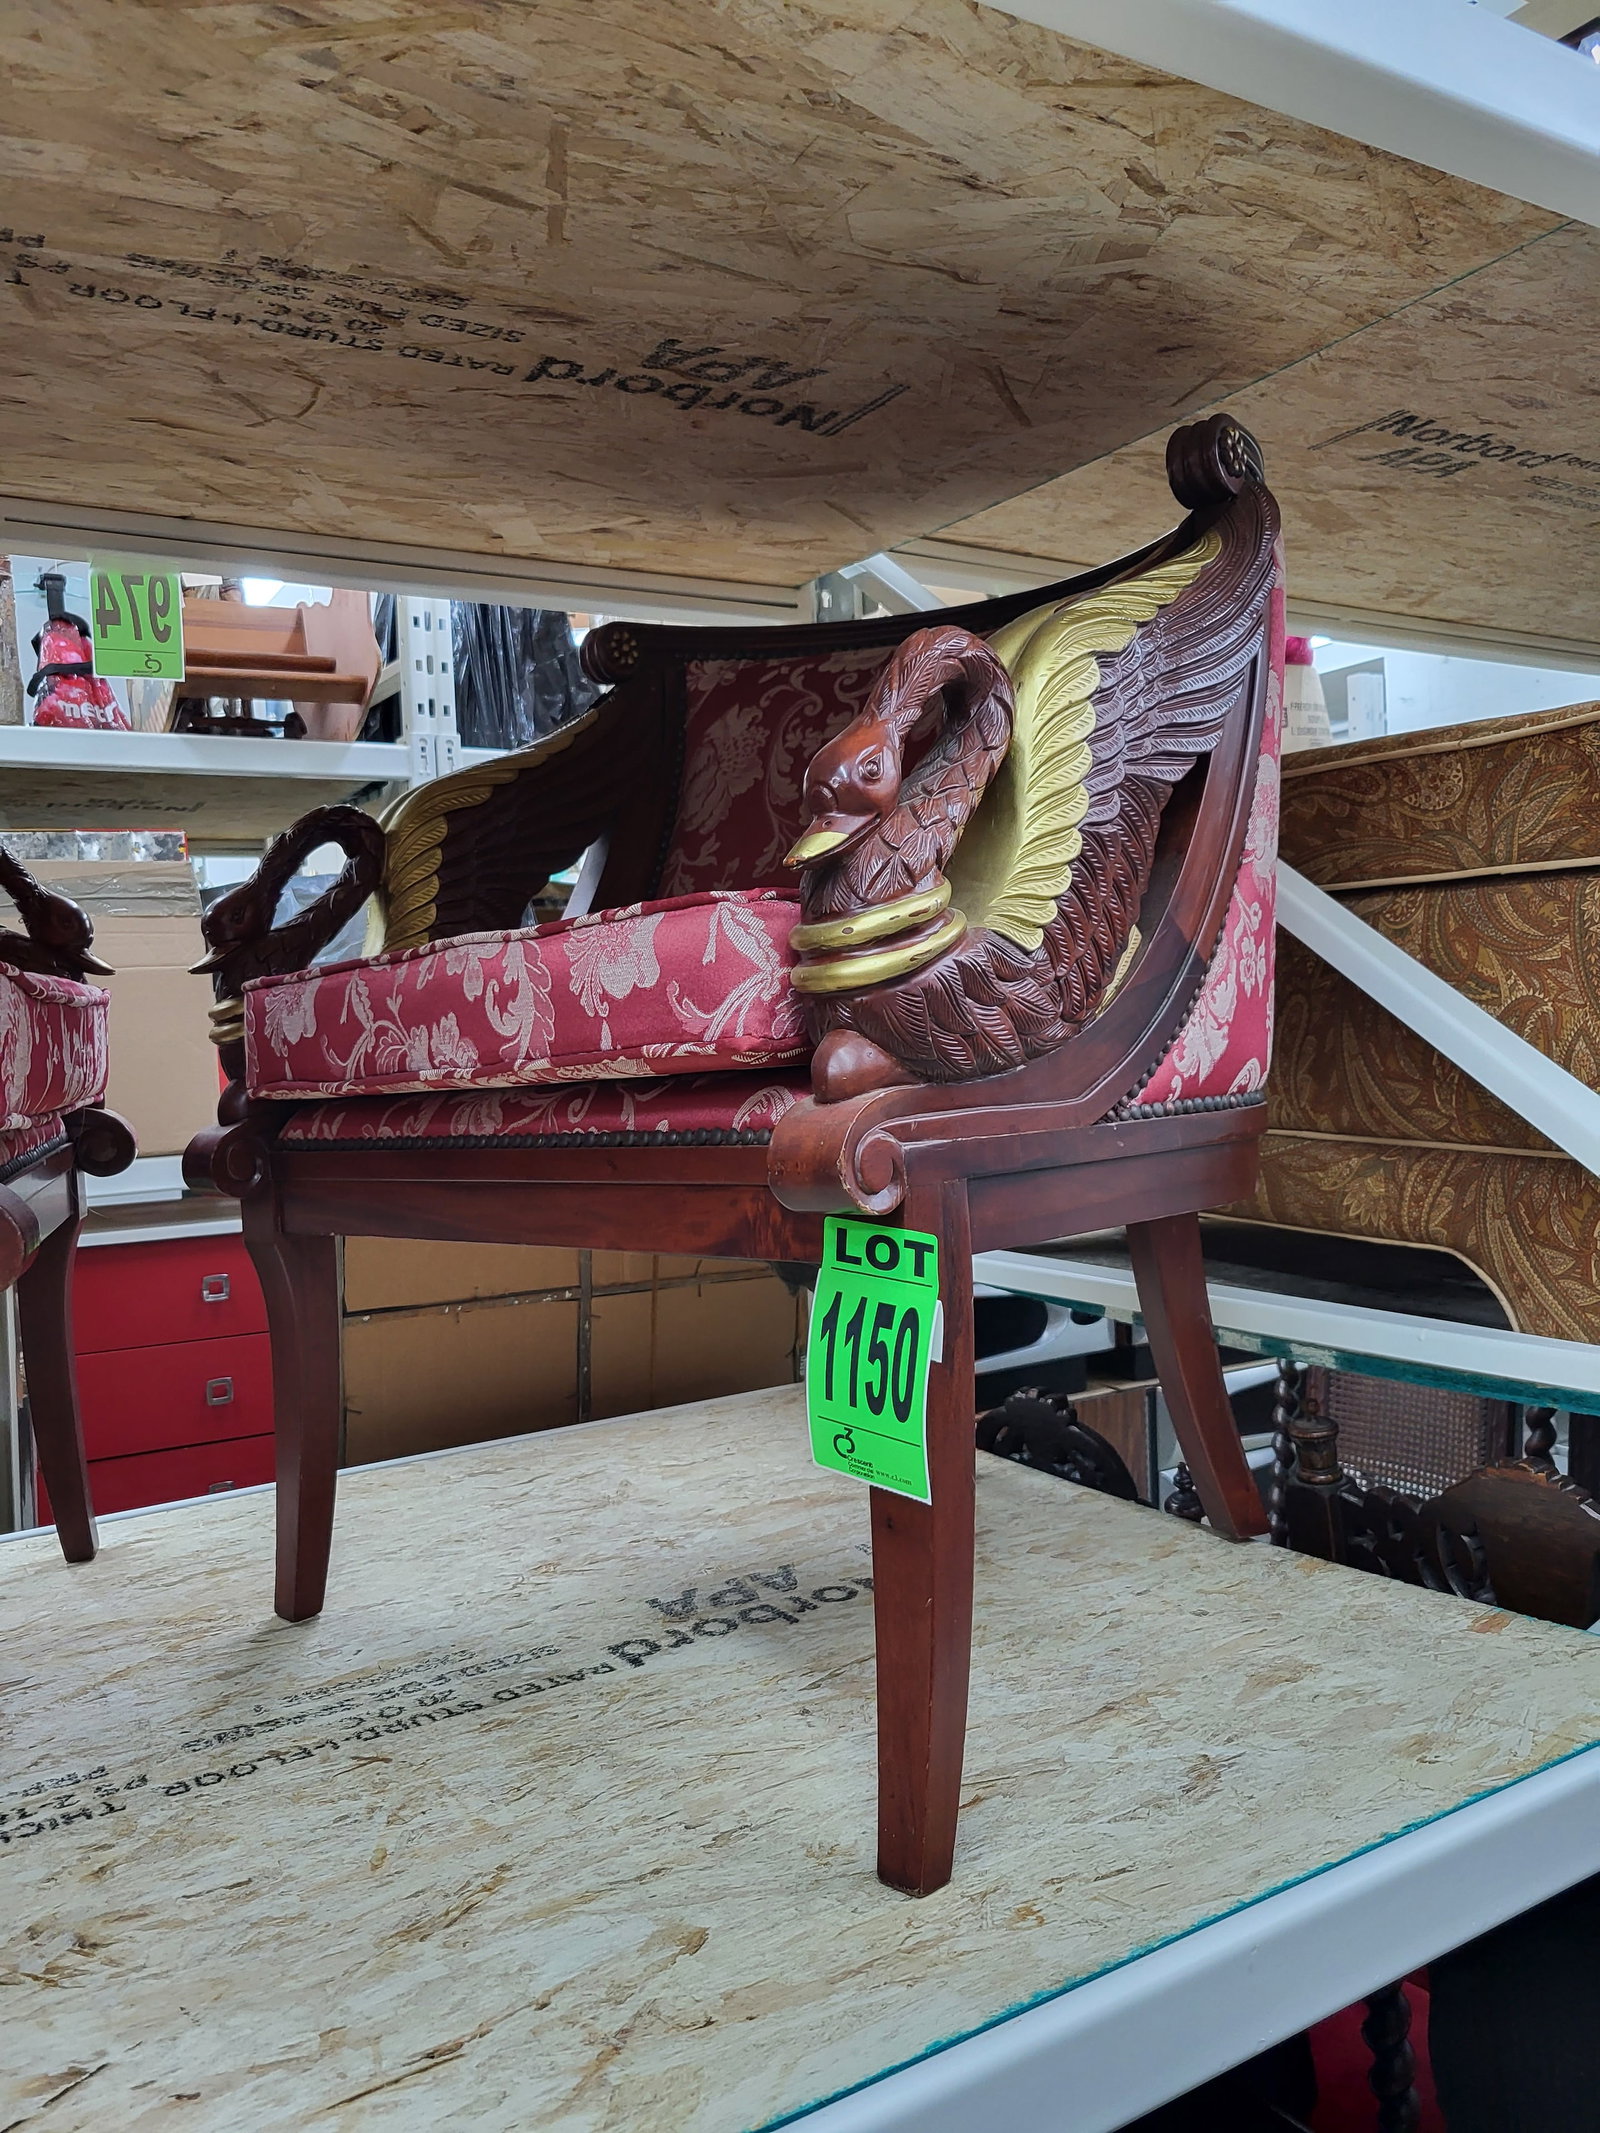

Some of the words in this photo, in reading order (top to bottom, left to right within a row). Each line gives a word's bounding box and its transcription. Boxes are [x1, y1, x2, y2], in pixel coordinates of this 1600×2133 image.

[417, 313, 527, 343] SIZED
[398, 345, 516, 377] RATED
[642, 338, 829, 391] APA
[522, 356, 841, 430] Norbord
[1374, 412, 1573, 469] Norbord
[835, 1227, 935, 1278] LOT
[820, 1291, 921, 1423] 1150
[645, 1563, 799, 1619] APA
[494, 1662, 616, 1701] RATED
